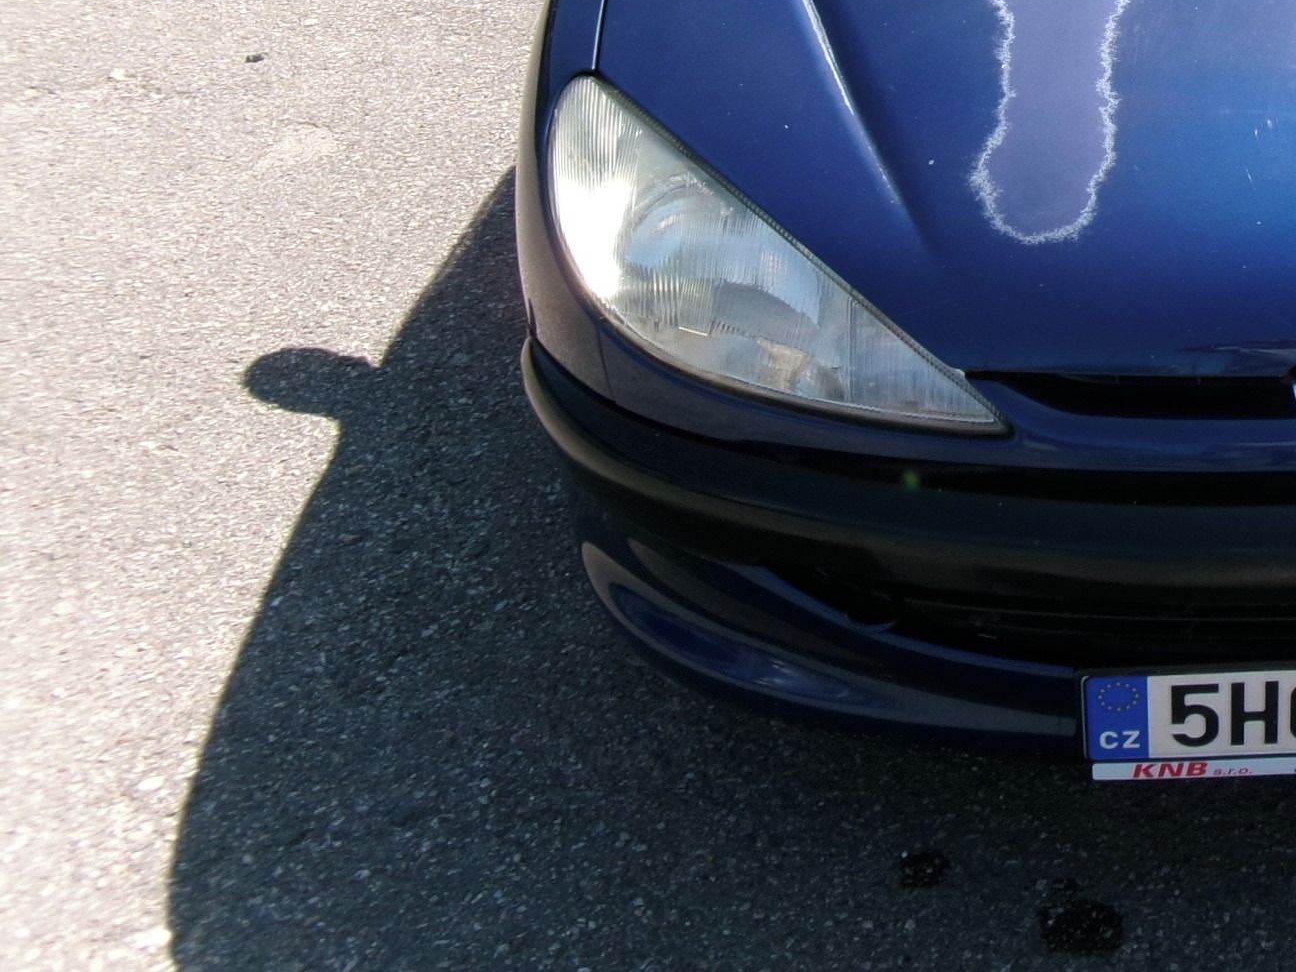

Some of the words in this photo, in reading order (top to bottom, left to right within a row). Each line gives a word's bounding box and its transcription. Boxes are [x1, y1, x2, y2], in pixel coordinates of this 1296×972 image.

[1099, 730, 1141, 750] CZ
[1132, 761, 1209, 779] KNB
[1213, 767, 1253, 776] s.r.o.
